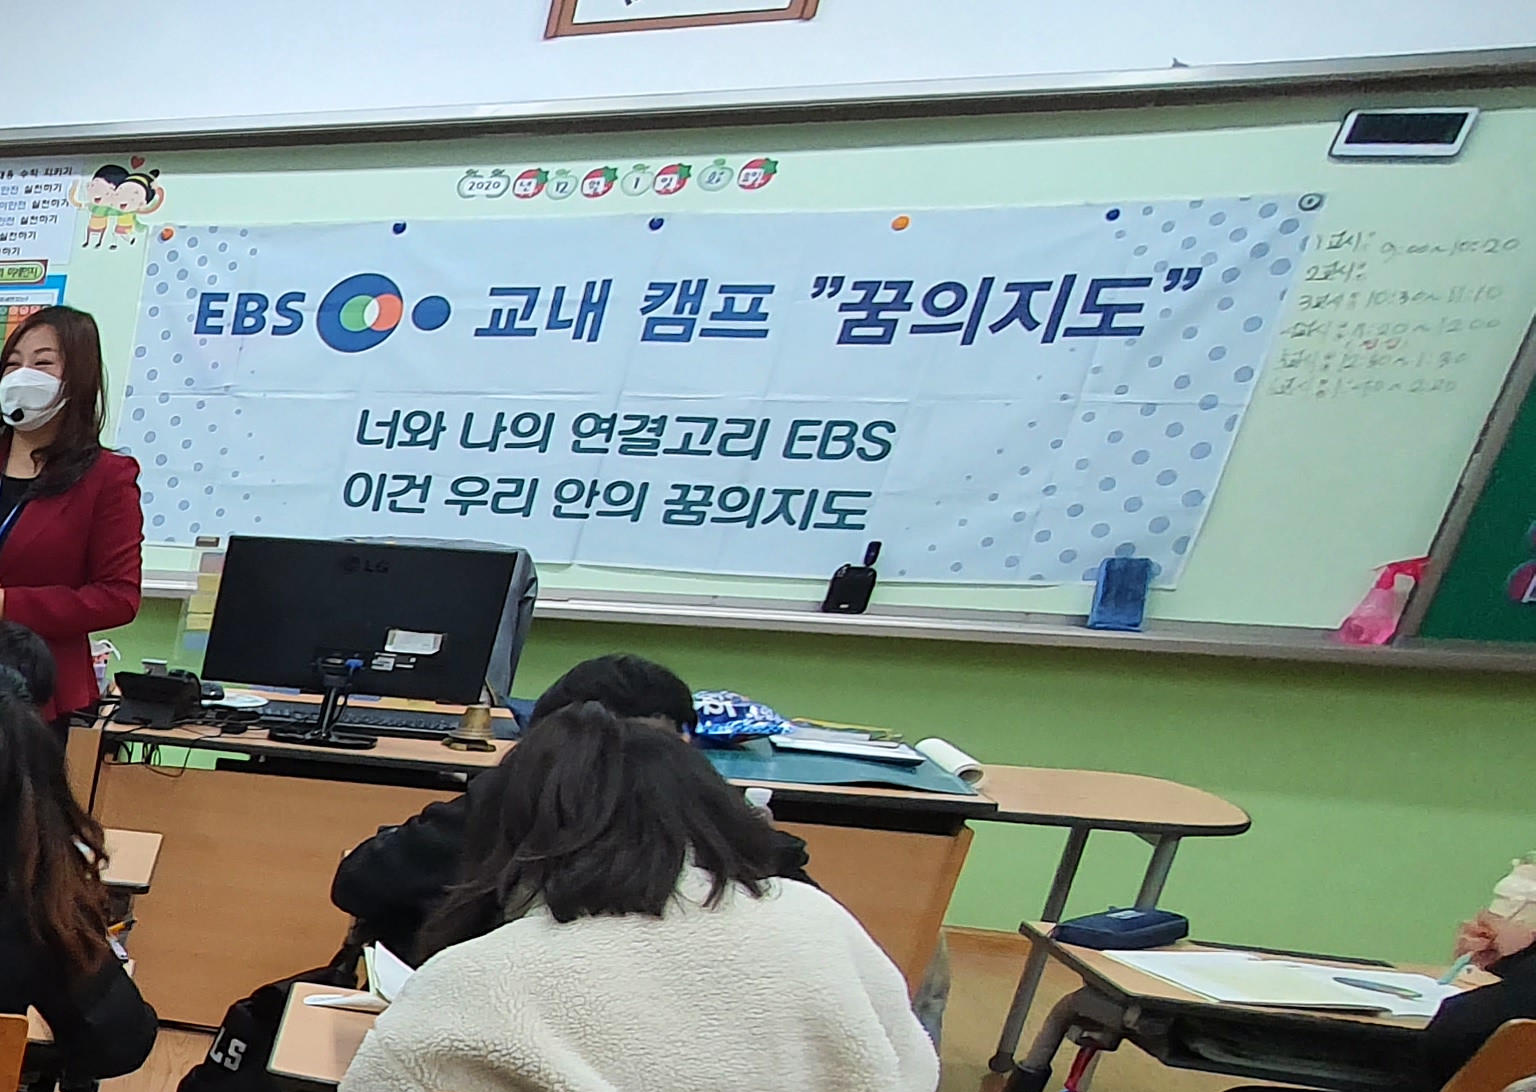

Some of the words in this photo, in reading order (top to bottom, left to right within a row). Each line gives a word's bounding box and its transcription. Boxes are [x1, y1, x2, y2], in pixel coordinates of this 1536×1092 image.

[468, 180, 501, 191] 2020
[555, 181, 569, 193] 12
[194, 290, 307, 337] EBS
[473, 278, 613, 343] 교내
[639, 278, 775, 343] 캠프
[355, 408, 446, 451] 너와
[459, 410, 555, 453] 나의
[571, 412, 770, 462] 연결고리
[782, 418, 896, 462] EBS
[343, 471, 432, 514] 이건
[443, 474, 538, 518] 우리
[552, 478, 649, 523] 안의
[662, 481, 872, 532] 꿈의지도
